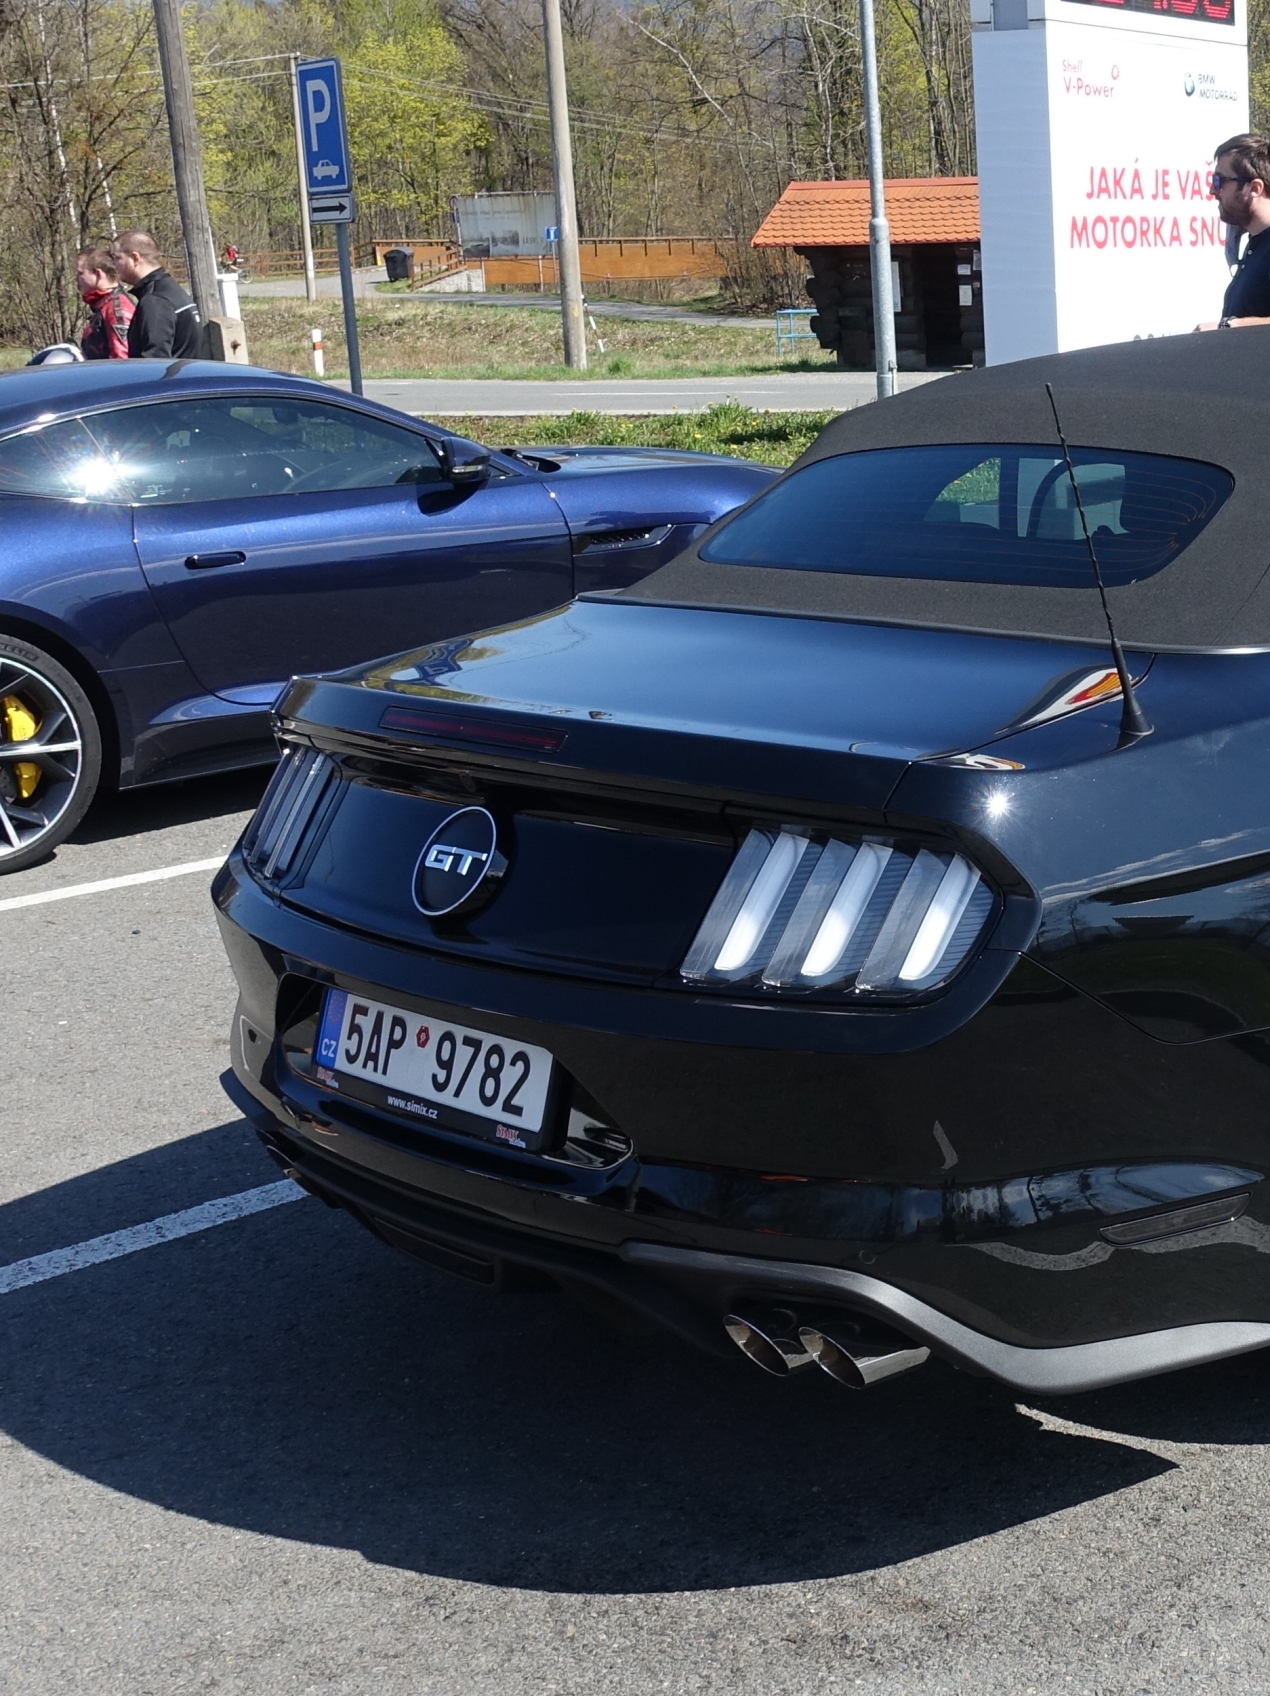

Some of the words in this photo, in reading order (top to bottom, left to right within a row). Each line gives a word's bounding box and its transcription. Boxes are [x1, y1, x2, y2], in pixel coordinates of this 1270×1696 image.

[1062, 59, 1083, 73] Shell
[1197, 73, 1216, 84] BMW
[1063, 76, 1114, 98] V-Power
[1199, 89, 1238, 101] MOTORRAD
[305, 79, 331, 152] P
[1086, 157, 1144, 200] JAKÁ
[1151, 169, 1170, 200] JE
[1070, 215, 1182, 249] MOTORKA
[425, 844, 488, 875] GT
[321, 1037, 337, 1058] CZ
[344, 1003, 408, 1076] 5AP
[431, 1031, 532, 1118] 9782
[387, 1095, 438, 1119] www.simix.cz
